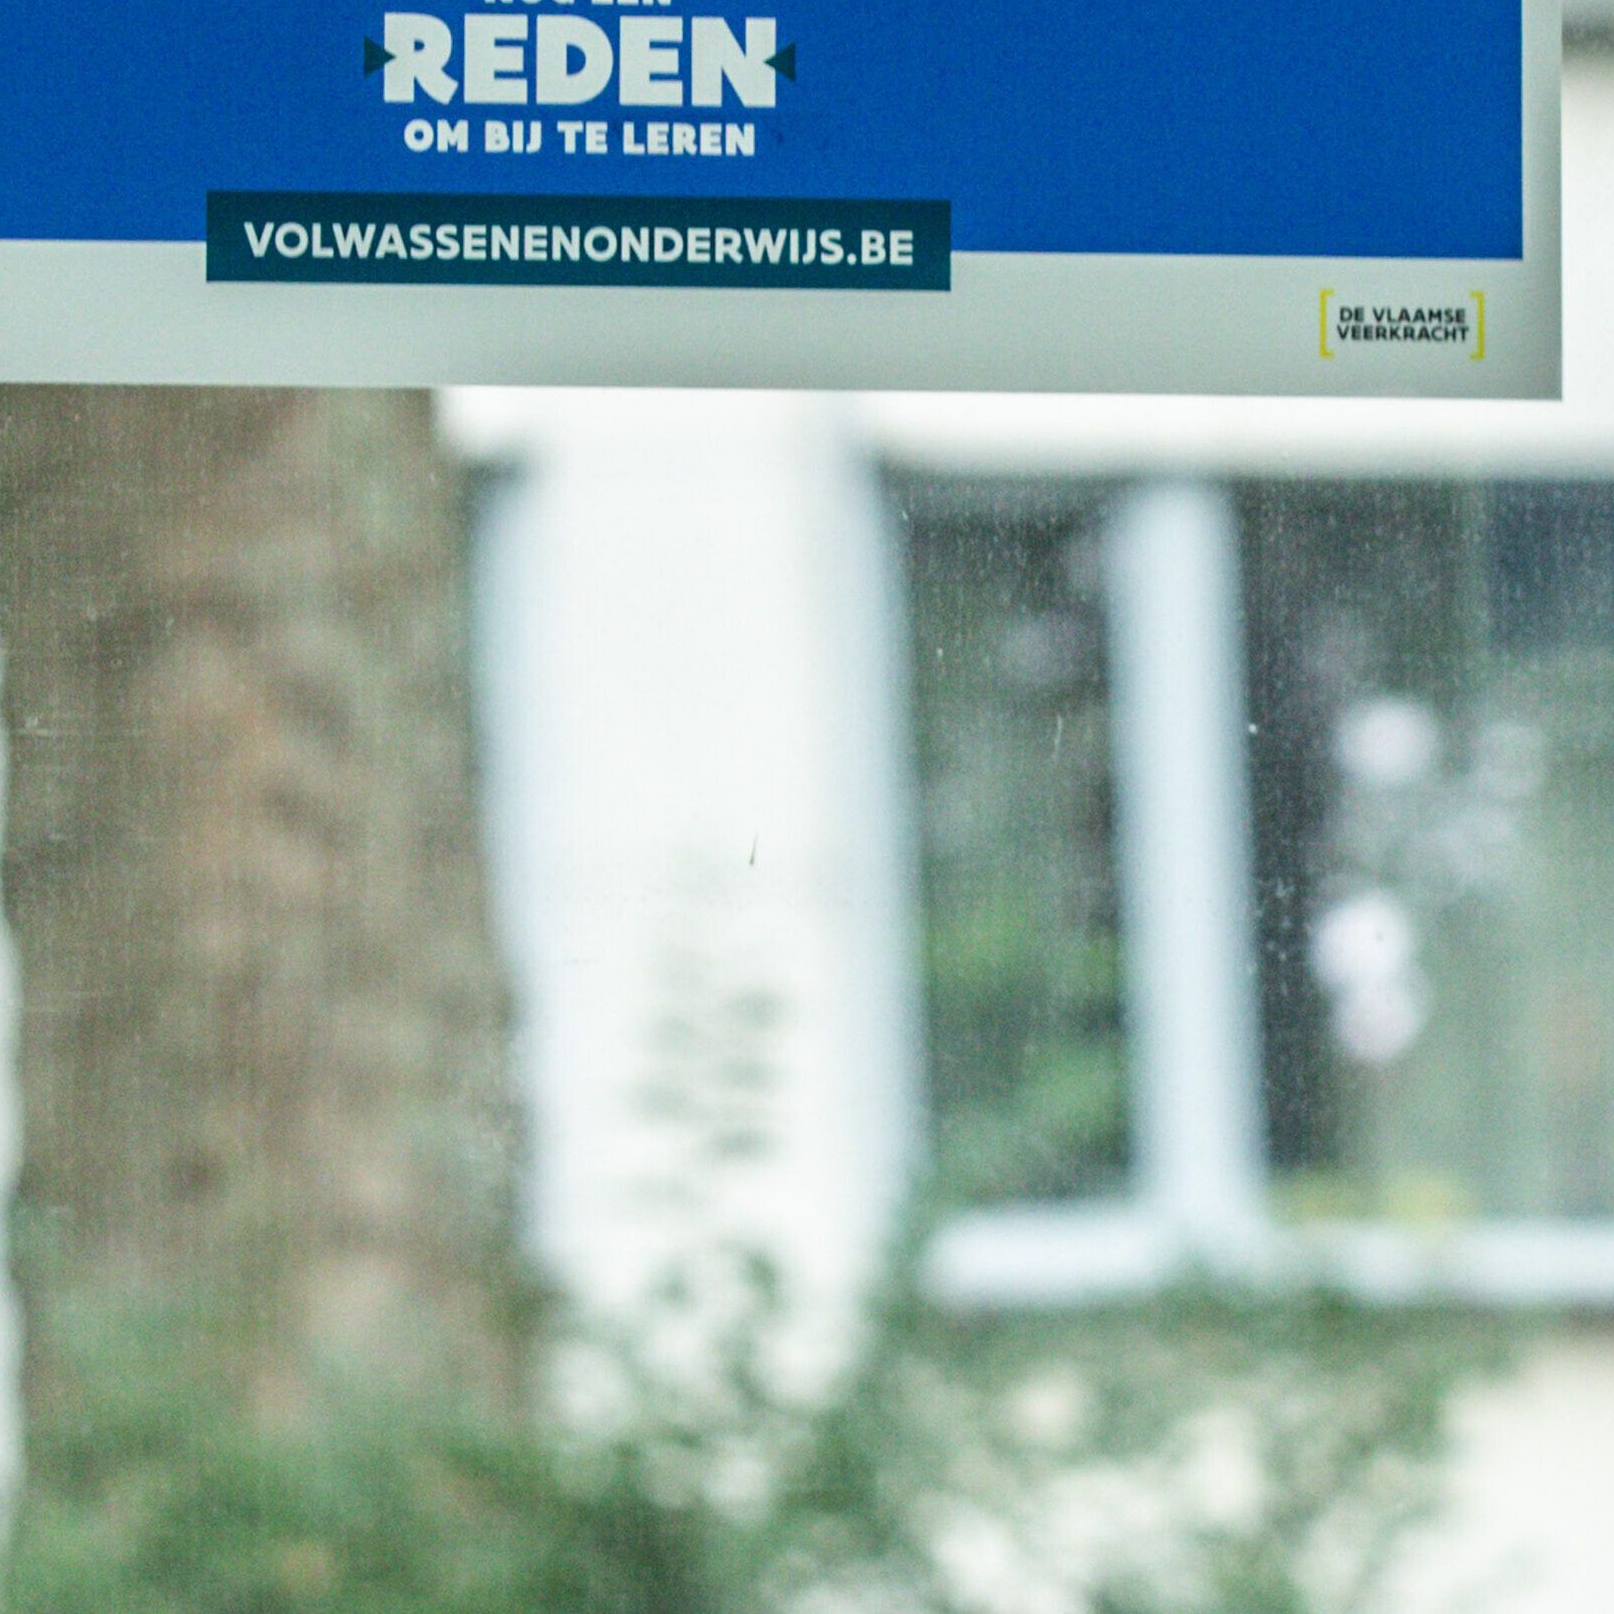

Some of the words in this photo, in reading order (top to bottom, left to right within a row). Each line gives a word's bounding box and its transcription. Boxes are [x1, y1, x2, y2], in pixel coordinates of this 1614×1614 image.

[382, 11, 778, 109] REDEN
[402, 118, 469, 153] OM
[483, 119, 543, 154] BIJ
[556, 120, 608, 155] TE
[621, 121, 756, 157] LEREN
[242, 220, 915, 267] VOLWASSENENONDERWIJS.BE
[1336, 324, 1470, 343] VEERKRACHT
[1338, 306, 1366, 324] DE
[1372, 307, 1467, 325] VLAAMSE
